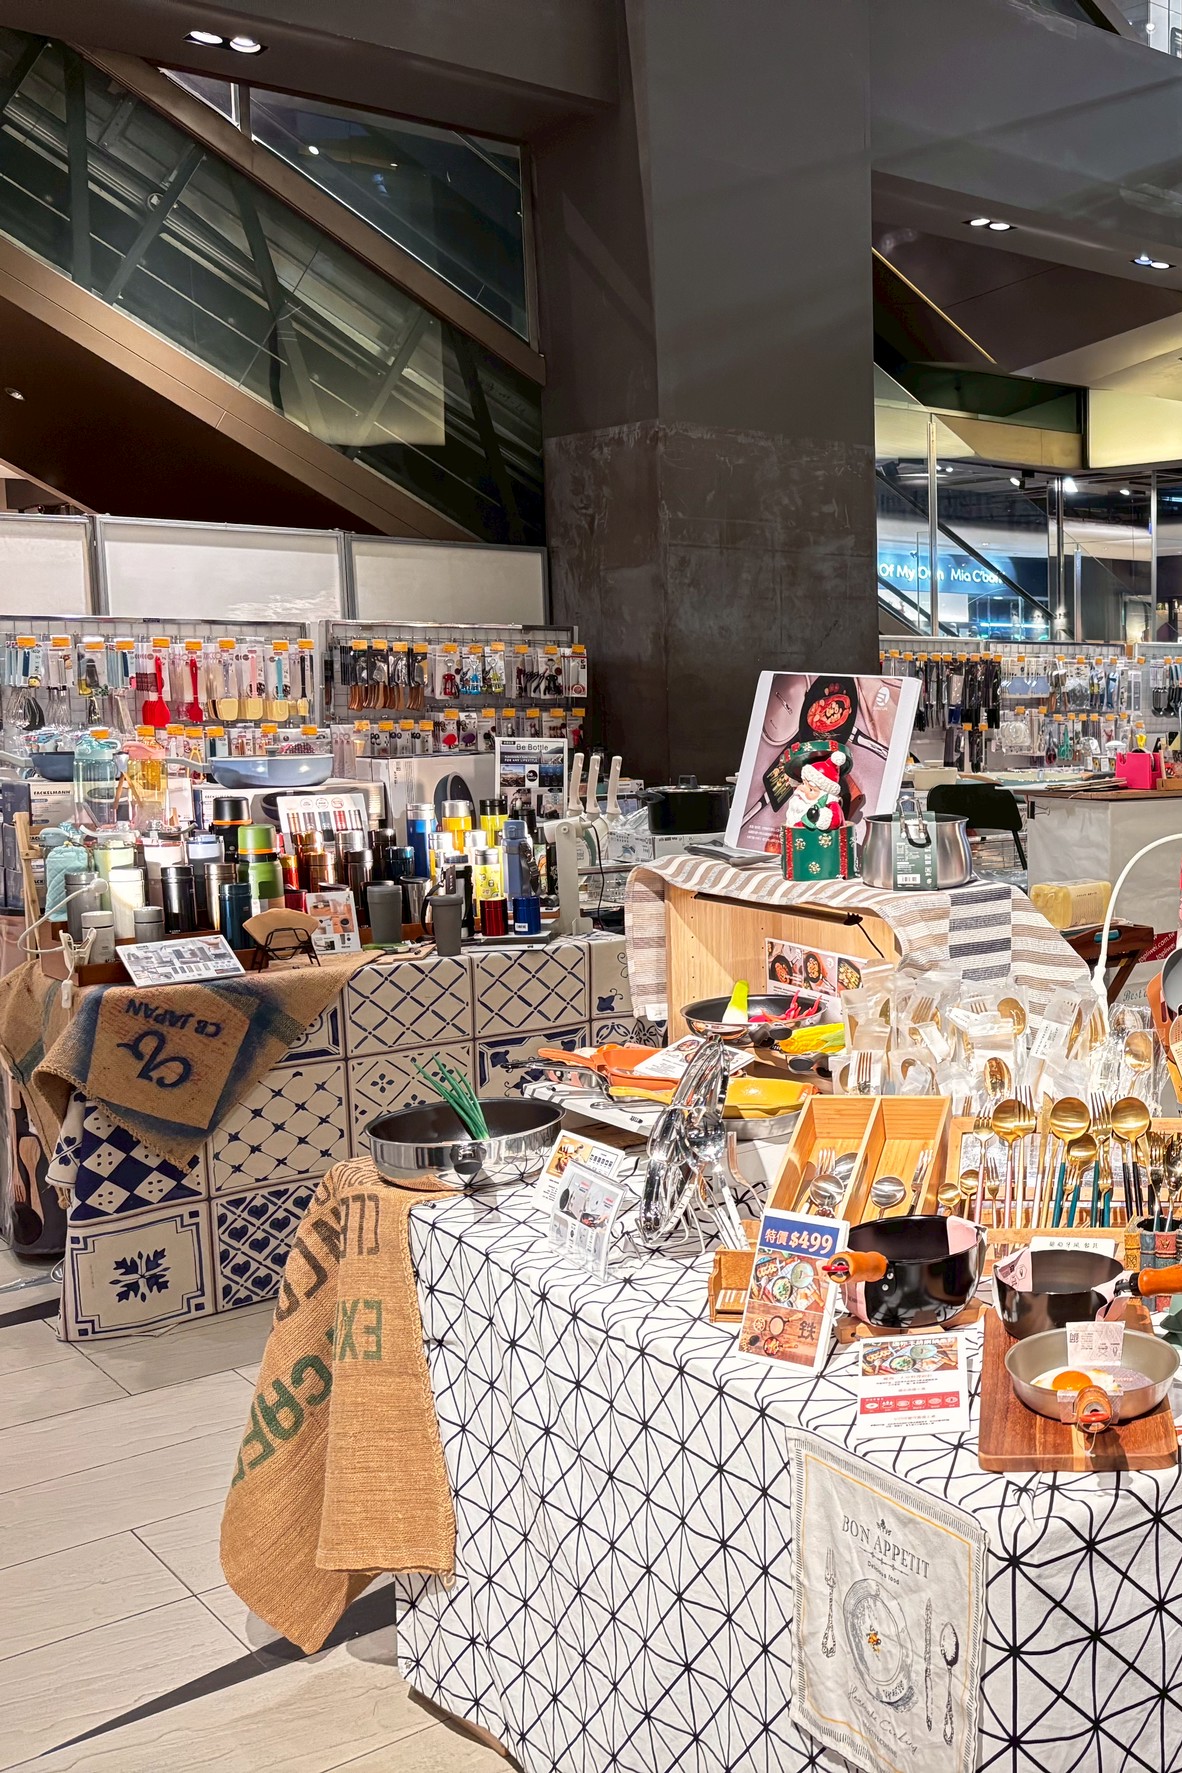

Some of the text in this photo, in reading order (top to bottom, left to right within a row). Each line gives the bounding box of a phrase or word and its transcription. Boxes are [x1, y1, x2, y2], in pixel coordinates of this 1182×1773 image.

[879, 563, 894, 577] Of
[896, 565, 915, 582] My
[917, 566, 945, 582] On
[950, 568, 972, 582] Mia
[516, 743, 526, 751] Be
[527, 743, 549, 751] Bottle
[126, 998, 222, 1038] CB JAPAN
[765, 1228, 833, 1254] 特價 $499
[842, 1514, 930, 1579] BON APPETIT
